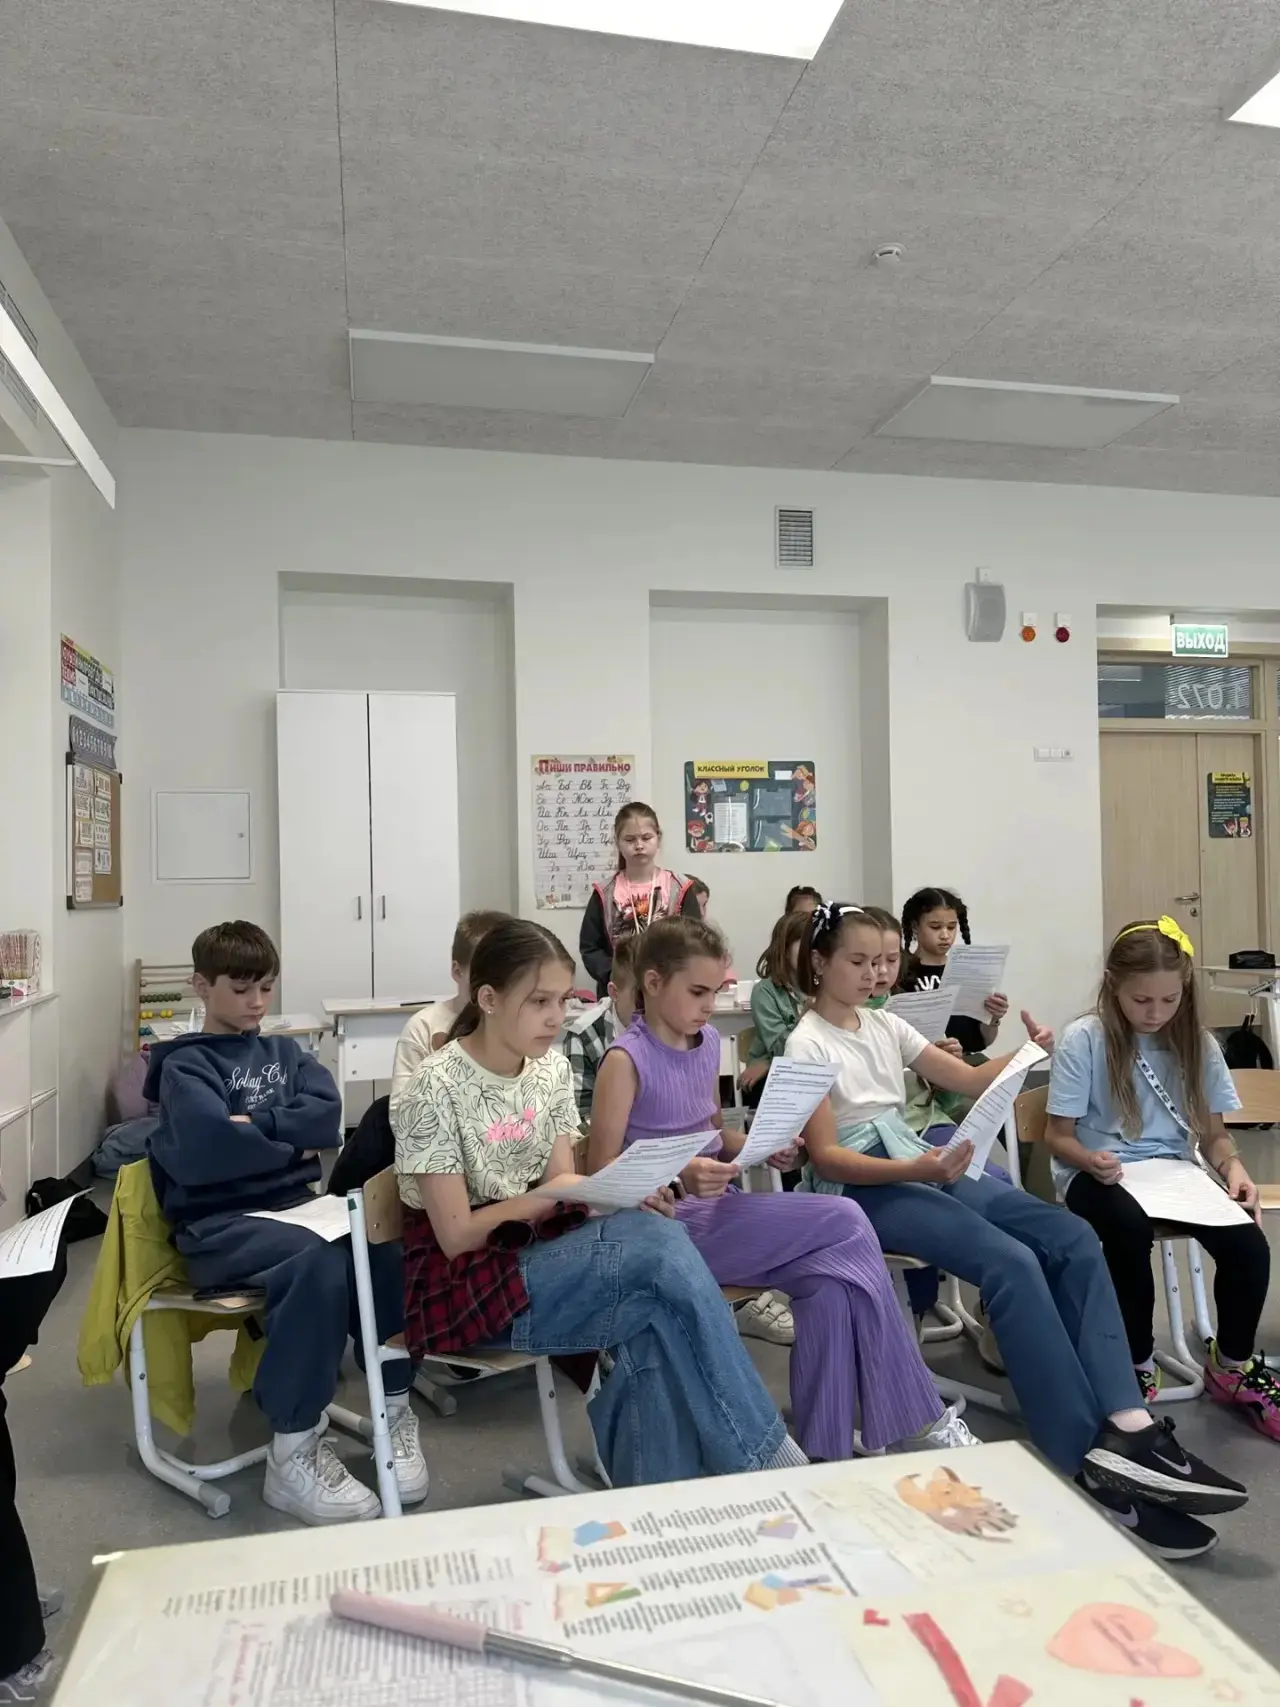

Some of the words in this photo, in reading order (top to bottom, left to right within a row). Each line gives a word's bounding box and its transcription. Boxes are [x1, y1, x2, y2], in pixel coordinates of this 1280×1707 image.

[1176, 632, 1226, 653] ВЫХОД
[538, 759, 572, 773] ПИШИ
[574, 763, 631, 773] ПРАВИЛЬНО
